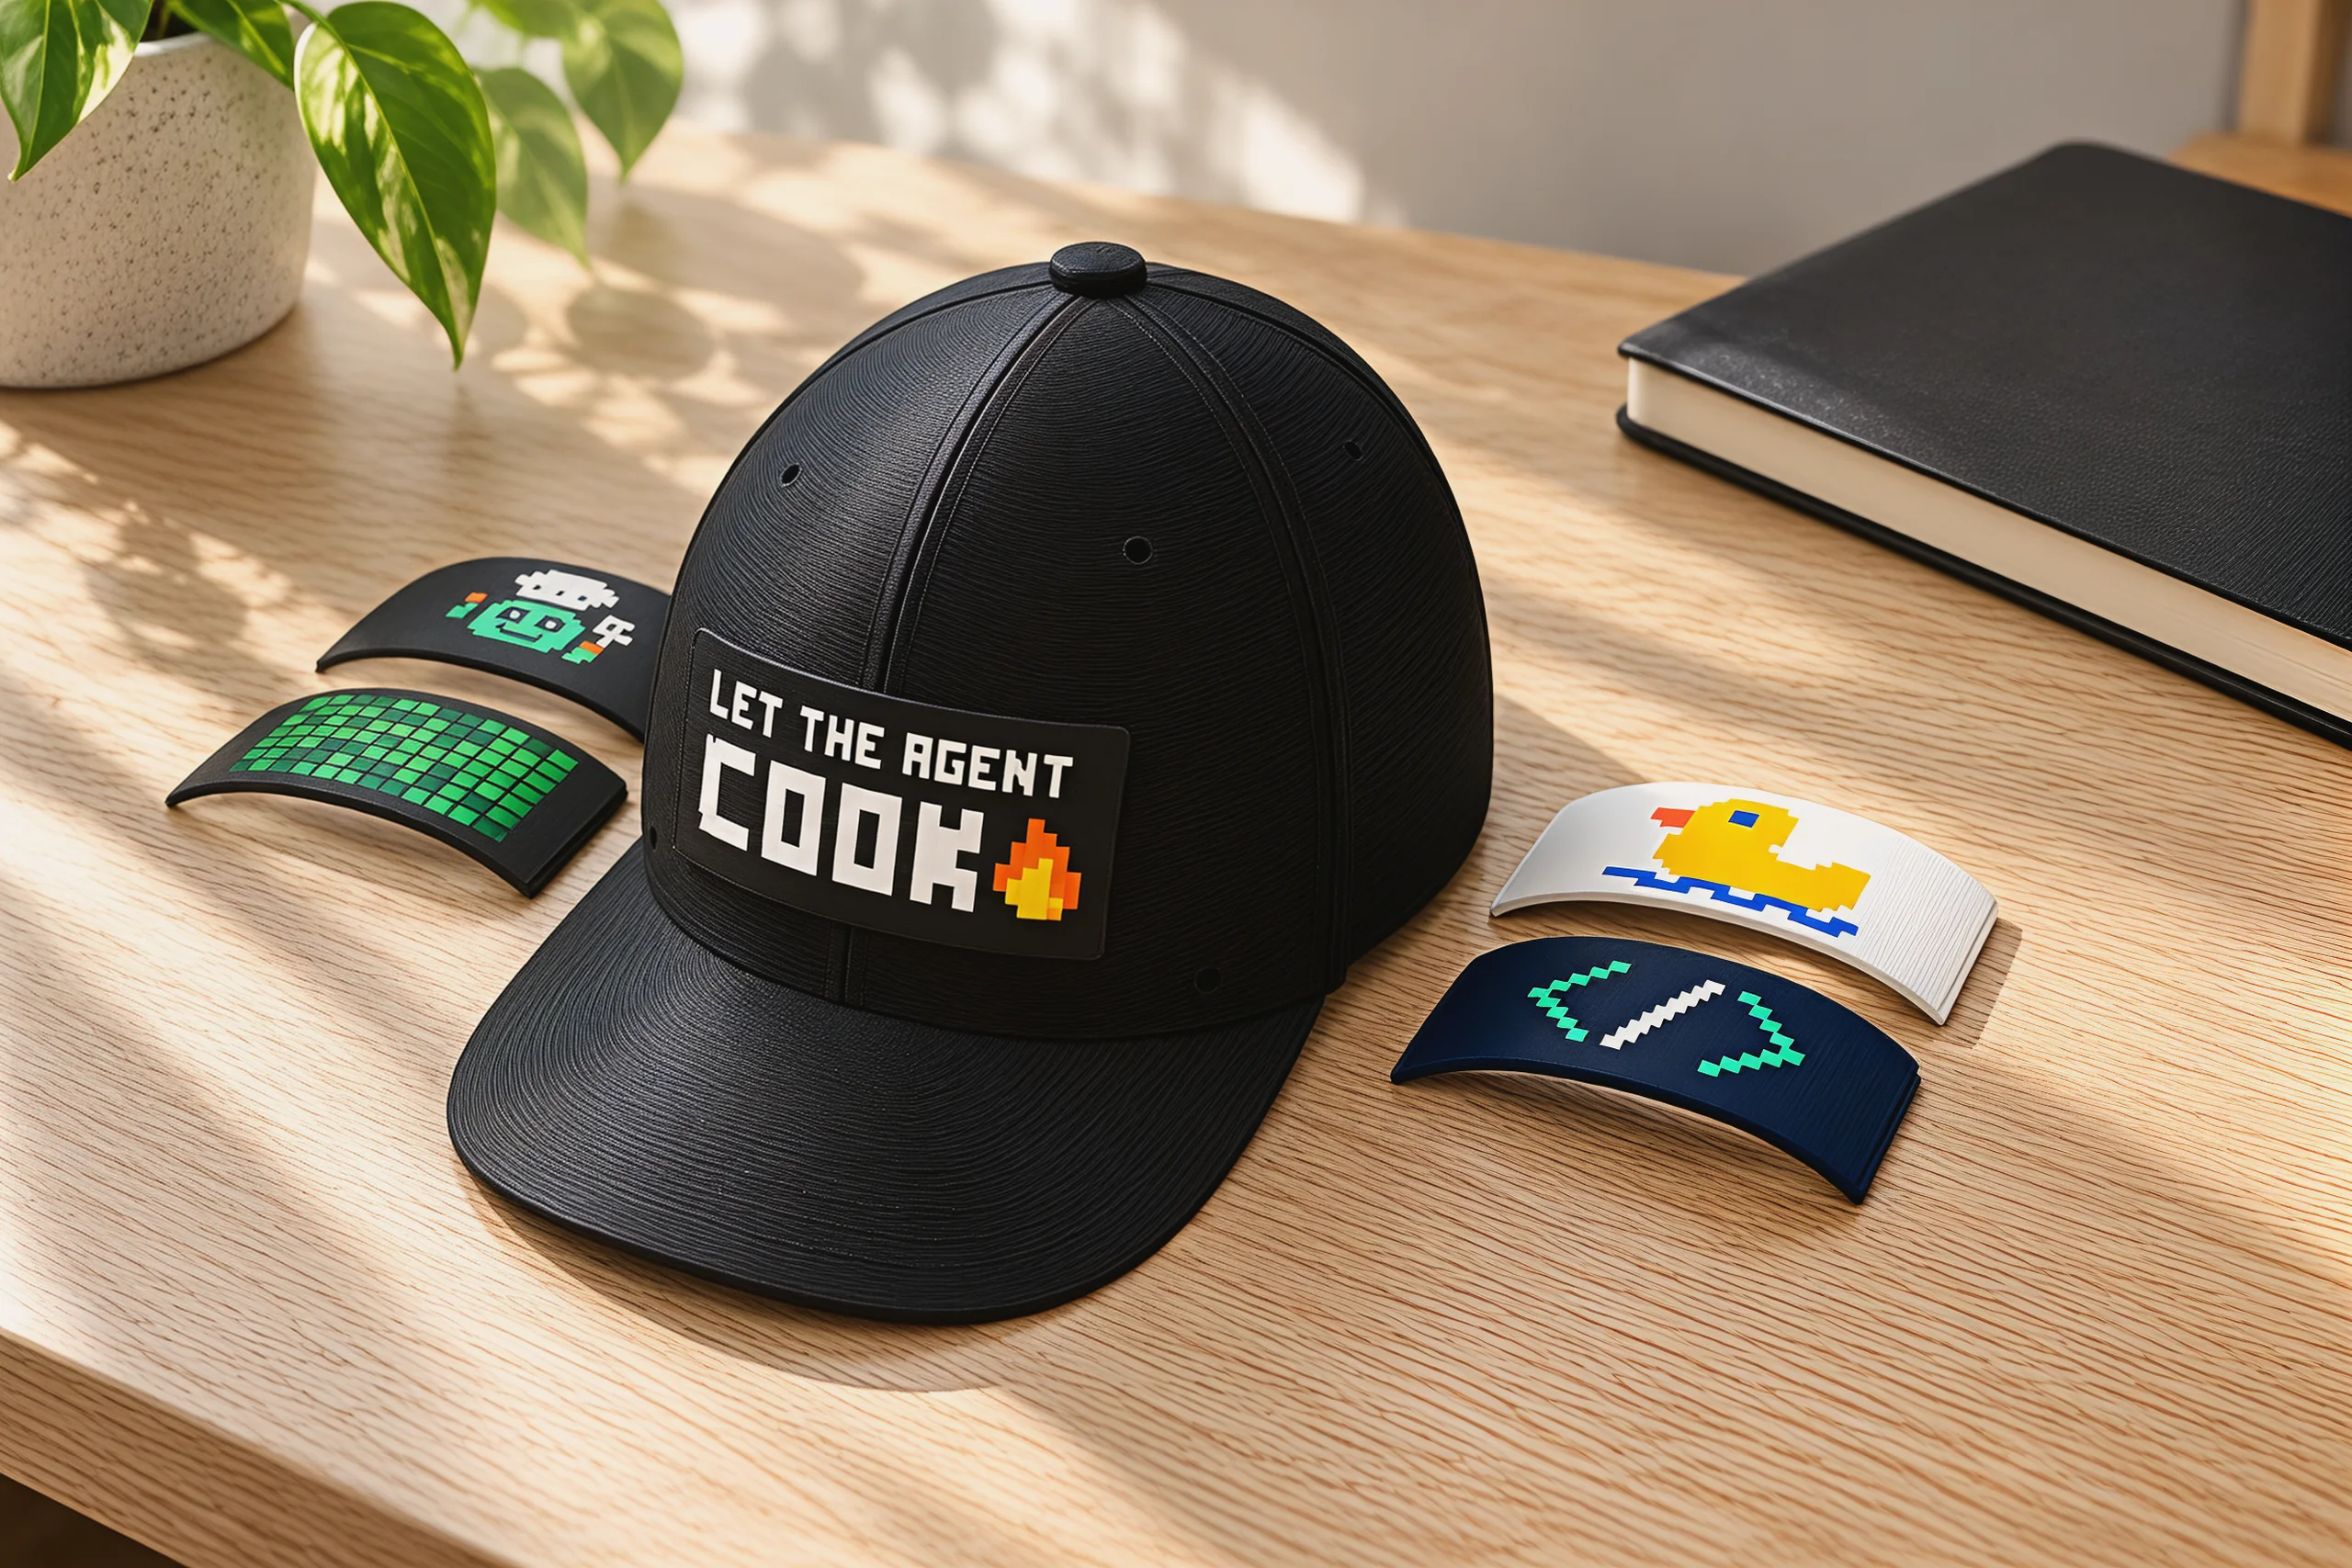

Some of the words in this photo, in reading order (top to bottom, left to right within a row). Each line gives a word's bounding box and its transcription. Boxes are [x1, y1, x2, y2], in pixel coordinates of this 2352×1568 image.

[709, 668, 784, 739] LET
[799, 705, 885, 770] THE
[901, 732, 1074, 799] AGENT
[697, 733, 985, 913] COOK
